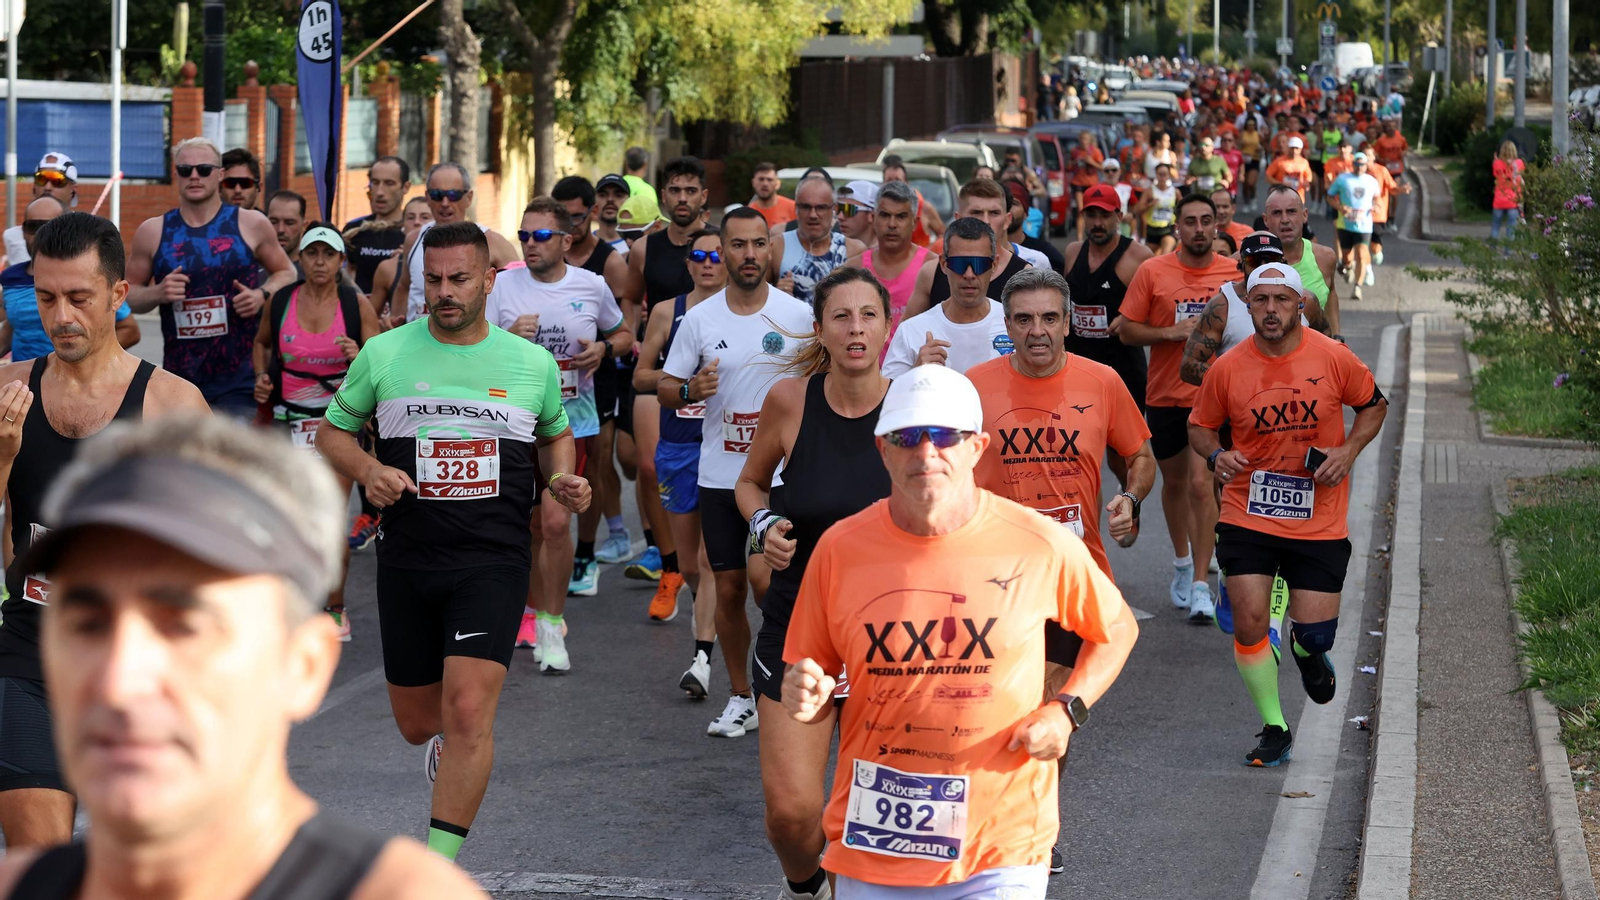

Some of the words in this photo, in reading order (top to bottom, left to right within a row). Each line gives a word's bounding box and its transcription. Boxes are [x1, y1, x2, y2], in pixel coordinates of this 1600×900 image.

[308, 6, 327, 26] 1h
[311, 32, 332, 53] 45
[186, 311, 212, 325] 199
[1075, 315, 1096, 327] 356
[406, 404, 509, 423] RUBYSAN
[436, 460, 479, 480] 328
[1260, 487, 1303, 506] 1050
[867, 667, 903, 676] MEDIA
[906, 663, 971, 676] MARATÓN
[973, 665, 992, 674] DE
[875, 797, 935, 832] 982
